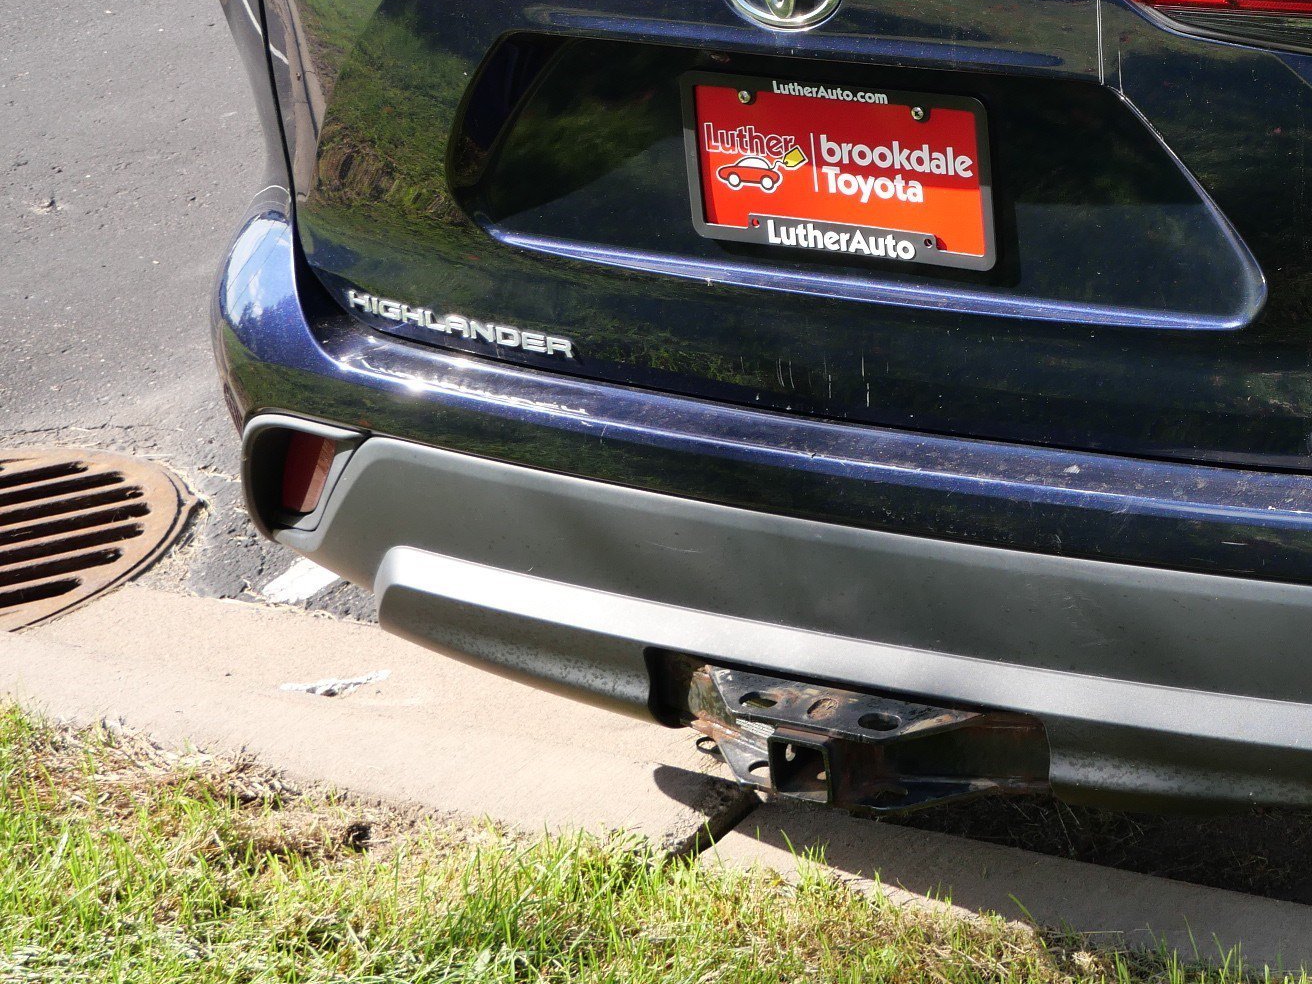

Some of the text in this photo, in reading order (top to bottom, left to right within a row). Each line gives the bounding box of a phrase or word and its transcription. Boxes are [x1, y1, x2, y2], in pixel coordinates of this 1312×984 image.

[773, 80, 888, 105] LutherAuto.com
[703, 122, 796, 159] Luther
[820, 134, 974, 178] brookdale
[821, 166, 925, 204] Toyota
[767, 219, 917, 261] LutherAuto
[348, 289, 576, 359] HIGHLANDER
